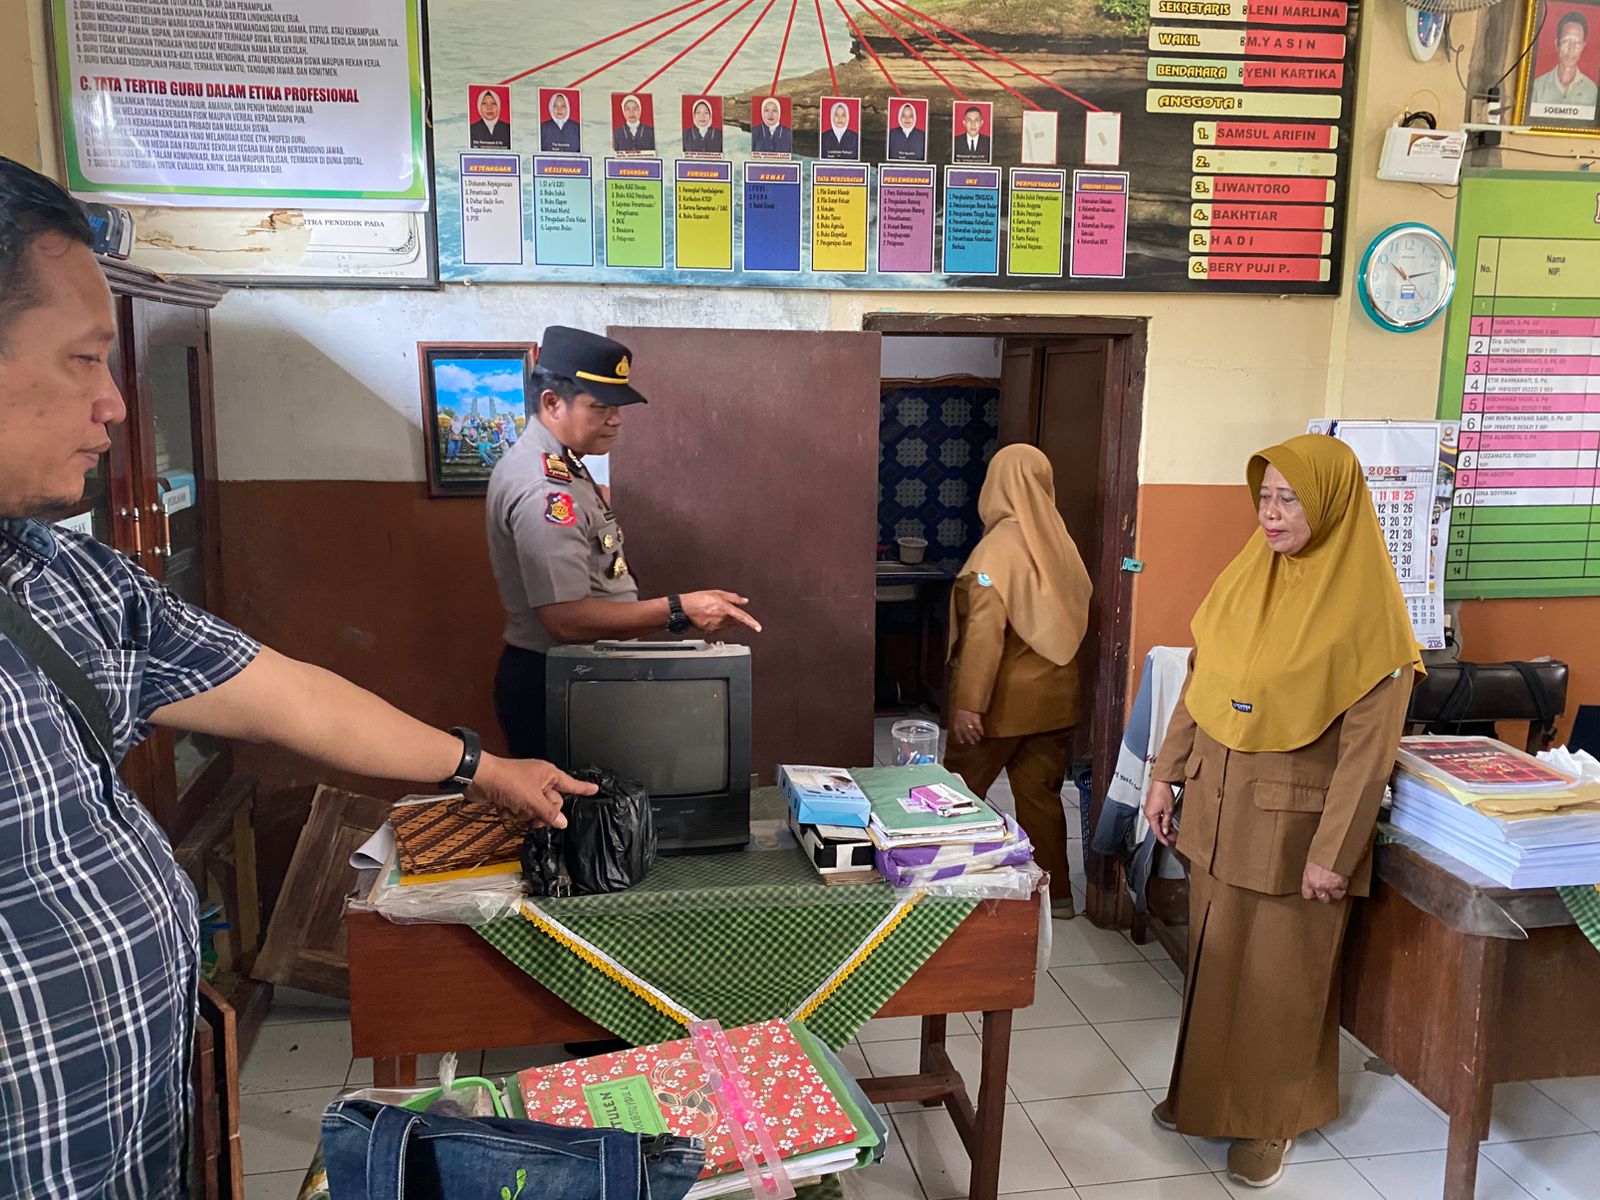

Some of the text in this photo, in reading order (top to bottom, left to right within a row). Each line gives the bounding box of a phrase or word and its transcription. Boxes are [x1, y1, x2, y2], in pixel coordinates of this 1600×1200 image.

[80, 2, 95, 11] GURU
[96, 2, 124, 12] MENJAGA
[125, 4, 160, 15] KEBERSIHAN
[162, 7, 174, 16] DAN
[175, 8, 202, 18] KERAPIAN
[204, 9, 228, 19] PAKAIAN
[230, 11, 246, 21] SERTA
[248, 12, 281, 22] LINGKUNGAN
[1159, 0, 1231, 15] SEKRETARIS
[1250, 5, 1277, 16] LENI
[1282, 6, 1340, 18] MARLINA
[83, 34, 98, 45] GURU
[98, 34, 116, 44] TIDAK
[117, 36, 153, 46] MELAKUKAN
[154, 38, 182, 48] TINDAKAN
[184, 40, 198, 49] YANG
[199, 41, 216, 50] DAPAT
[251, 44, 267, 53] NAMA
[1158, 34, 1200, 46] WAKIL
[84, 55, 99, 64] GURU
[100, 56, 128, 65] MENJAGA
[128, 58, 168, 68] KEDISIPLINAN
[194, 62, 223, 71] TERMASUK
[246, 66, 275, 74] TANGGUNG
[1157, 65, 1227, 79] BENDAHARA
[1246, 68, 1276, 78] YENI
[1280, 68, 1336, 79] KARTIKA
[80, 76, 359, 102] C. TATA TERTIB GURU DALAM ETIKA PROFESIONAL
[1543, 106, 1579, 115] SOEMITO
[1198, 127, 1316, 141] 1. SAMSUL ARIFIN
[1196, 156, 1210, 168] 2.
[1195, 182, 1290, 194] 3. LIWANTORO
[1194, 209, 1278, 221] 4. BAKHTIAR
[1193, 234, 1207, 246] 5.
[1546, 255, 1566, 264] Nama
[1192, 261, 1290, 273] 6. BERY PUJI P.
[1480, 264, 1492, 273] No.
[1548, 267, 1561, 276] NIP.
[1478, 322, 1484, 333] 1
[1474, 341, 1483, 353] 2
[1472, 361, 1481, 373] 3
[1471, 380, 1479, 391] 4
[1469, 399, 1477, 410] 5
[1467, 418, 1475, 429] 6
[1466, 437, 1474, 448] 7
[1463, 456, 1472, 467] 8
[1369, 467, 1400, 475] 2026
[1461, 474, 1470, 486] 9
[1379, 491, 1414, 500] 11 18 25
[1456, 493, 1472, 505] 10
[1378, 504, 1413, 513] 12 19 26
[1390, 517, 1399, 526] 20
[1404, 516, 1412, 526] 27
[1390, 529, 1412, 539] 21 28
[1389, 542, 1412, 552] 22 29
[1402, 555, 1411, 564] 30
[1402, 568, 1410, 577] 31
